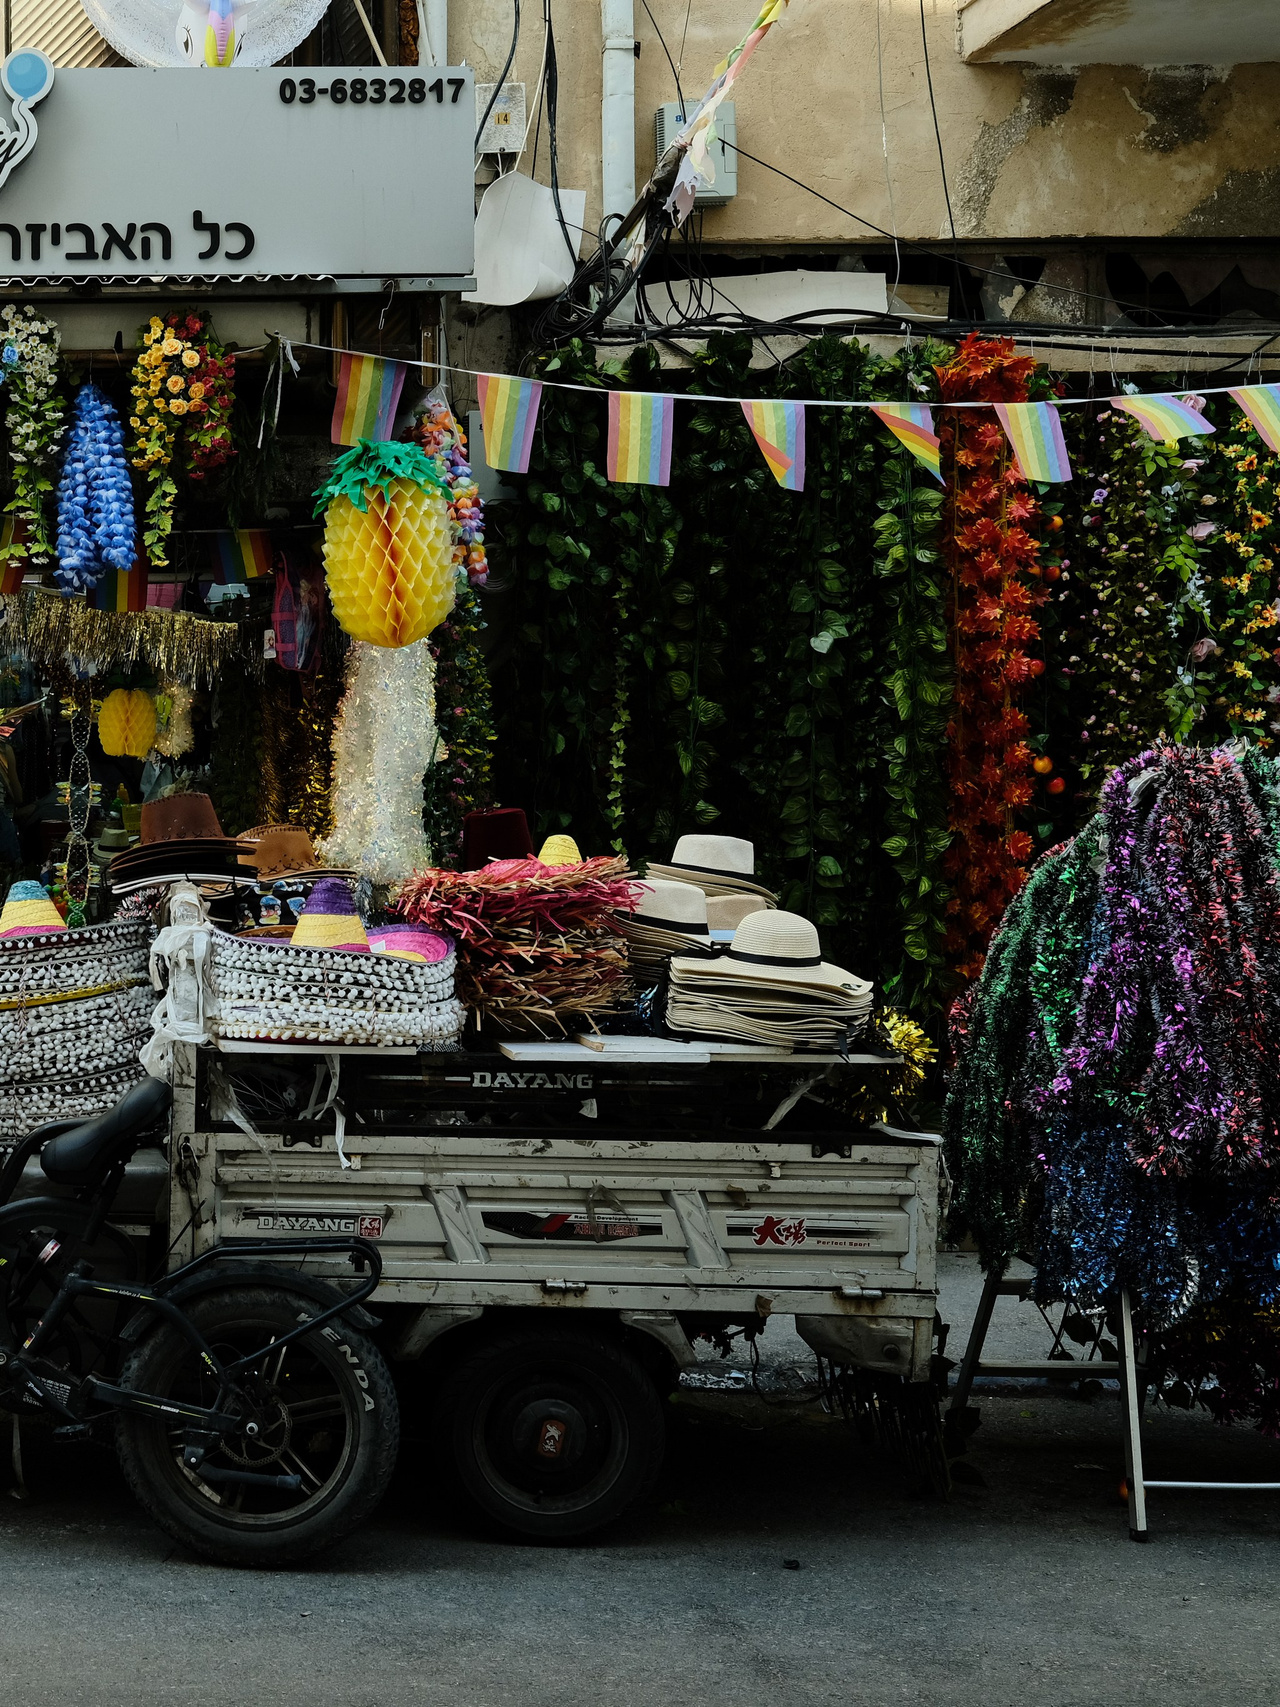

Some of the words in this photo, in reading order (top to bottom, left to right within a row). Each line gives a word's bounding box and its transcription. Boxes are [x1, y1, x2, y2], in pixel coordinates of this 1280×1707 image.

[280, 79, 465, 105] 03-6832817
[193, 209, 257, 262] כל
[472, 1071, 594, 1089] DAYANG
[257, 1216, 355, 1232] DAYANG
